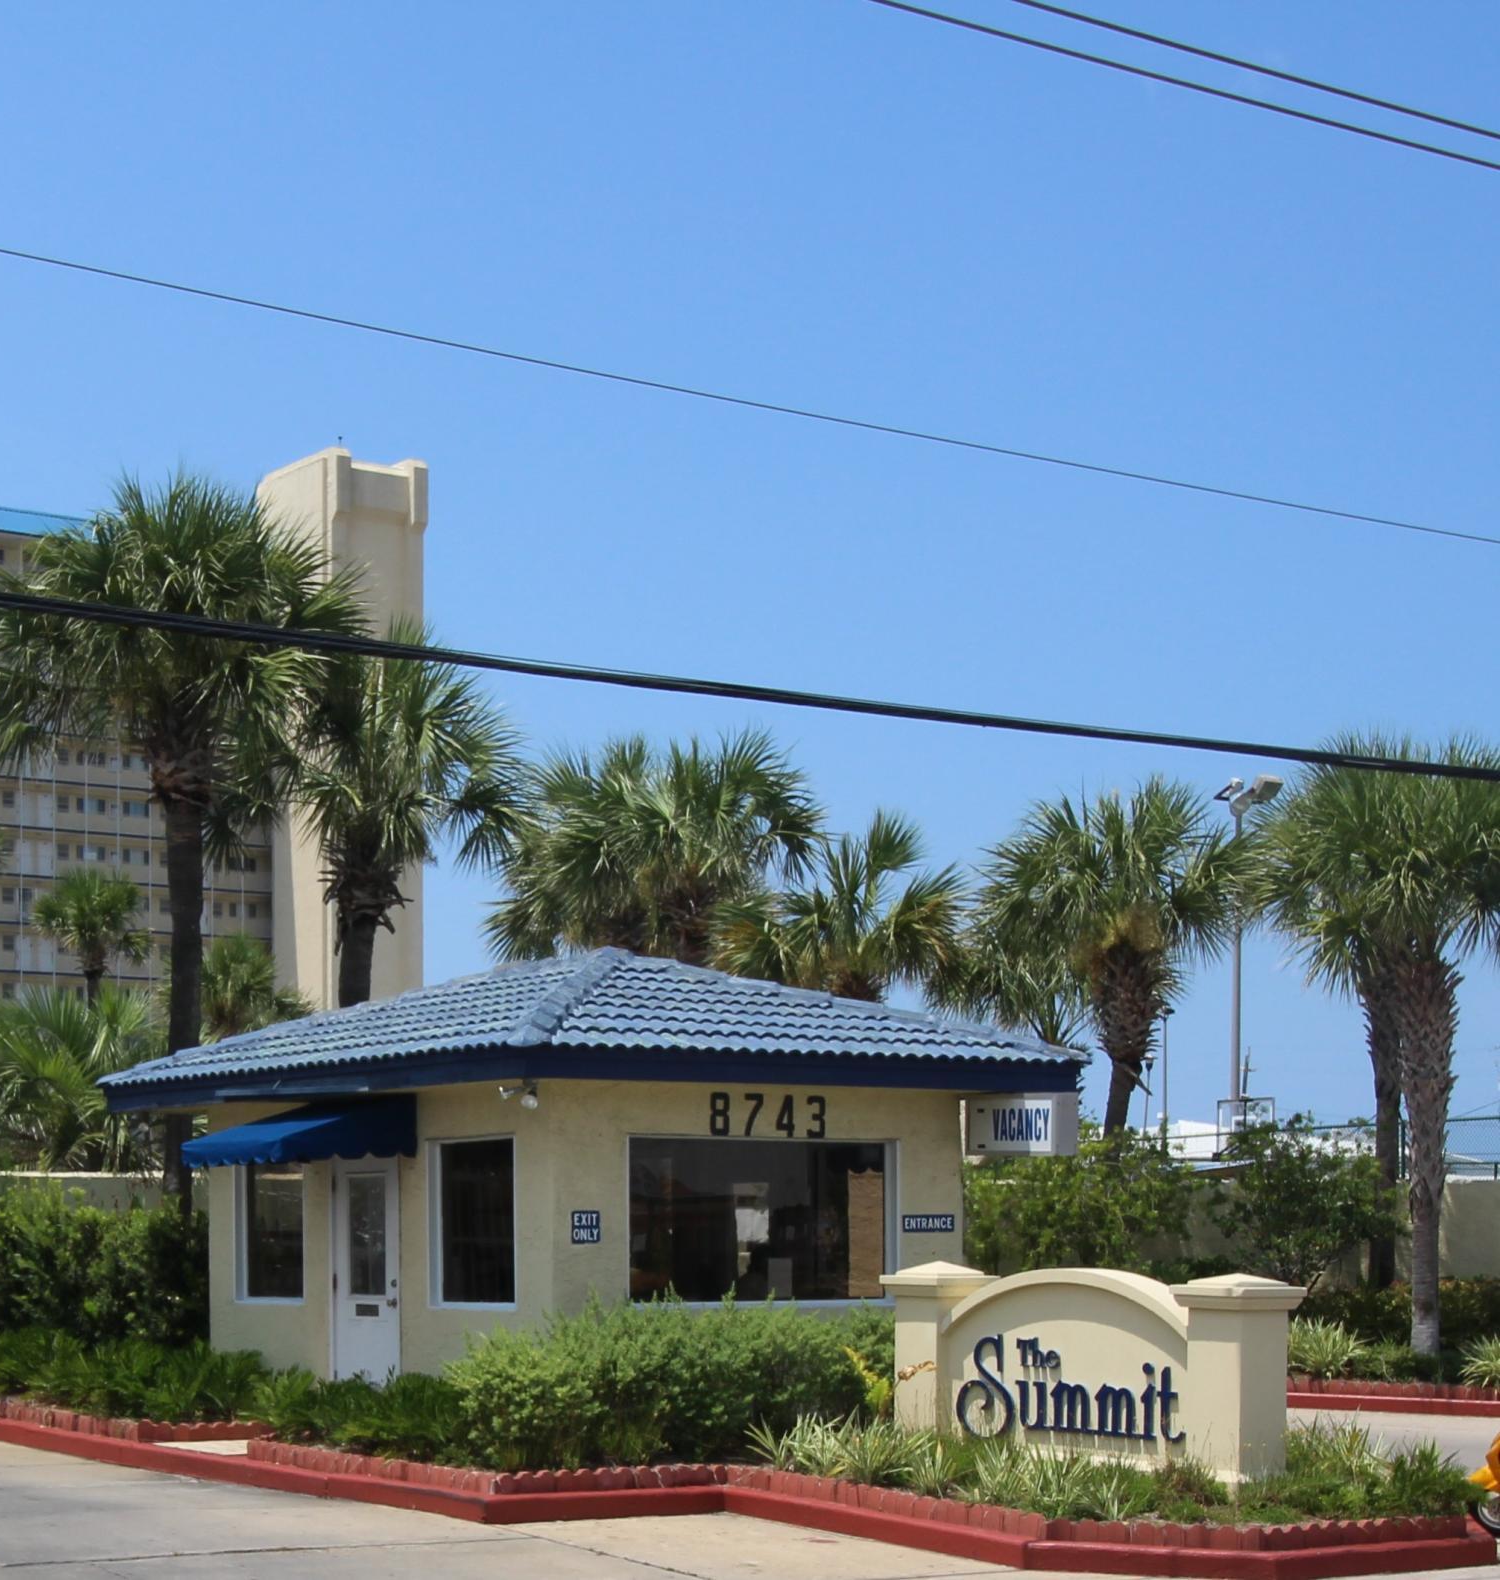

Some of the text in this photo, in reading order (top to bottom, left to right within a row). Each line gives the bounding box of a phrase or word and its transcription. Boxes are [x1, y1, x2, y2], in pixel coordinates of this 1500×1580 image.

[709, 1091, 826, 1139] 8743
[992, 1108, 1050, 1142] VACANCY
[573, 1213, 597, 1226] EXIT
[573, 1228, 599, 1241] ONLY
[904, 1217, 953, 1230] ENTRANCE
[1016, 1337, 1061, 1369] The
[955, 1333, 1187, 1445] Summit
